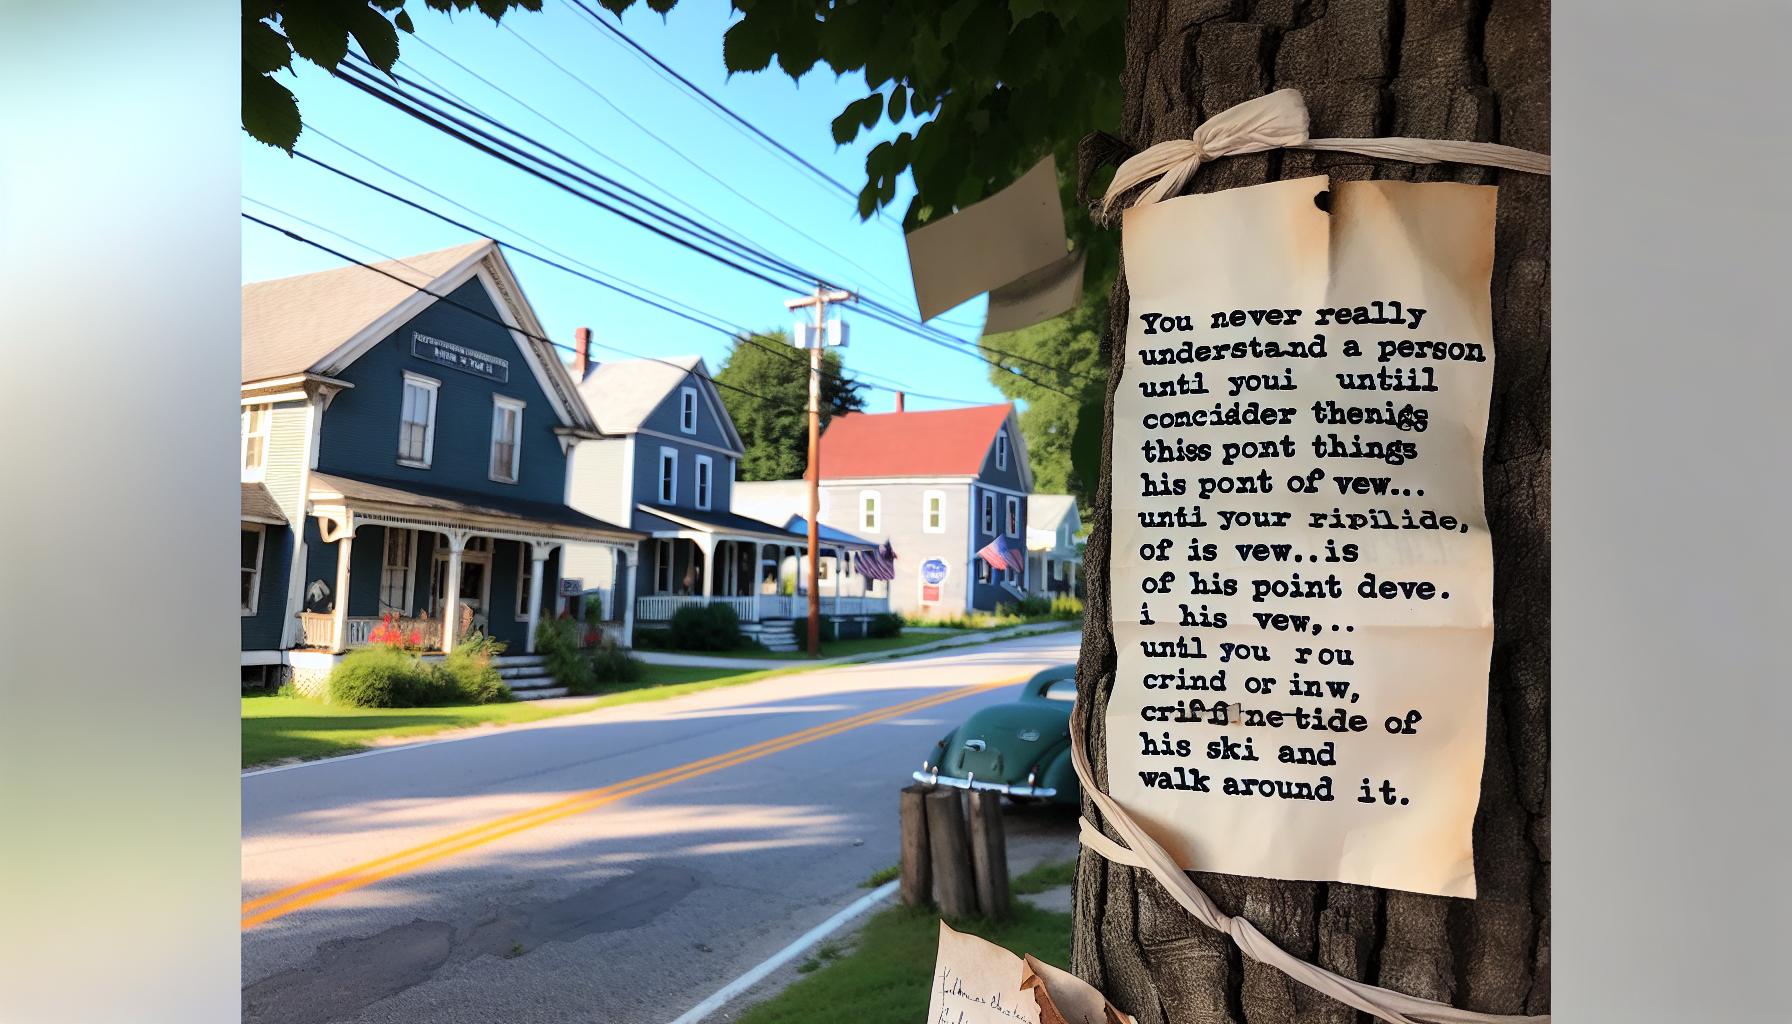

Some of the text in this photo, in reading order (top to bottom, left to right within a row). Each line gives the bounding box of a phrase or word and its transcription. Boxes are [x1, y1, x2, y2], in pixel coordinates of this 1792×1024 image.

[1140, 301, 1427, 334] You never really
[1139, 334, 1486, 365] understand a person
[1222, 435, 1295, 465] pont
[1312, 434, 1418, 465] things
[1141, 468, 1424, 499] his pont of vew...
[1217, 511, 1291, 530] your
[1140, 539, 1173, 561] of
[1188, 538, 1217, 561] is
[1142, 572, 1449, 602] of his point deve.
[1140, 602, 1155, 625] i
[1179, 604, 1227, 628] his
[1220, 643, 1270, 662] you
[1143, 668, 1226, 691] crind
[1245, 677, 1276, 694] or
[1385, 710, 1422, 734] of
[1139, 732, 1336, 766] his ski and
[1139, 767, 1409, 805] walk around it.
